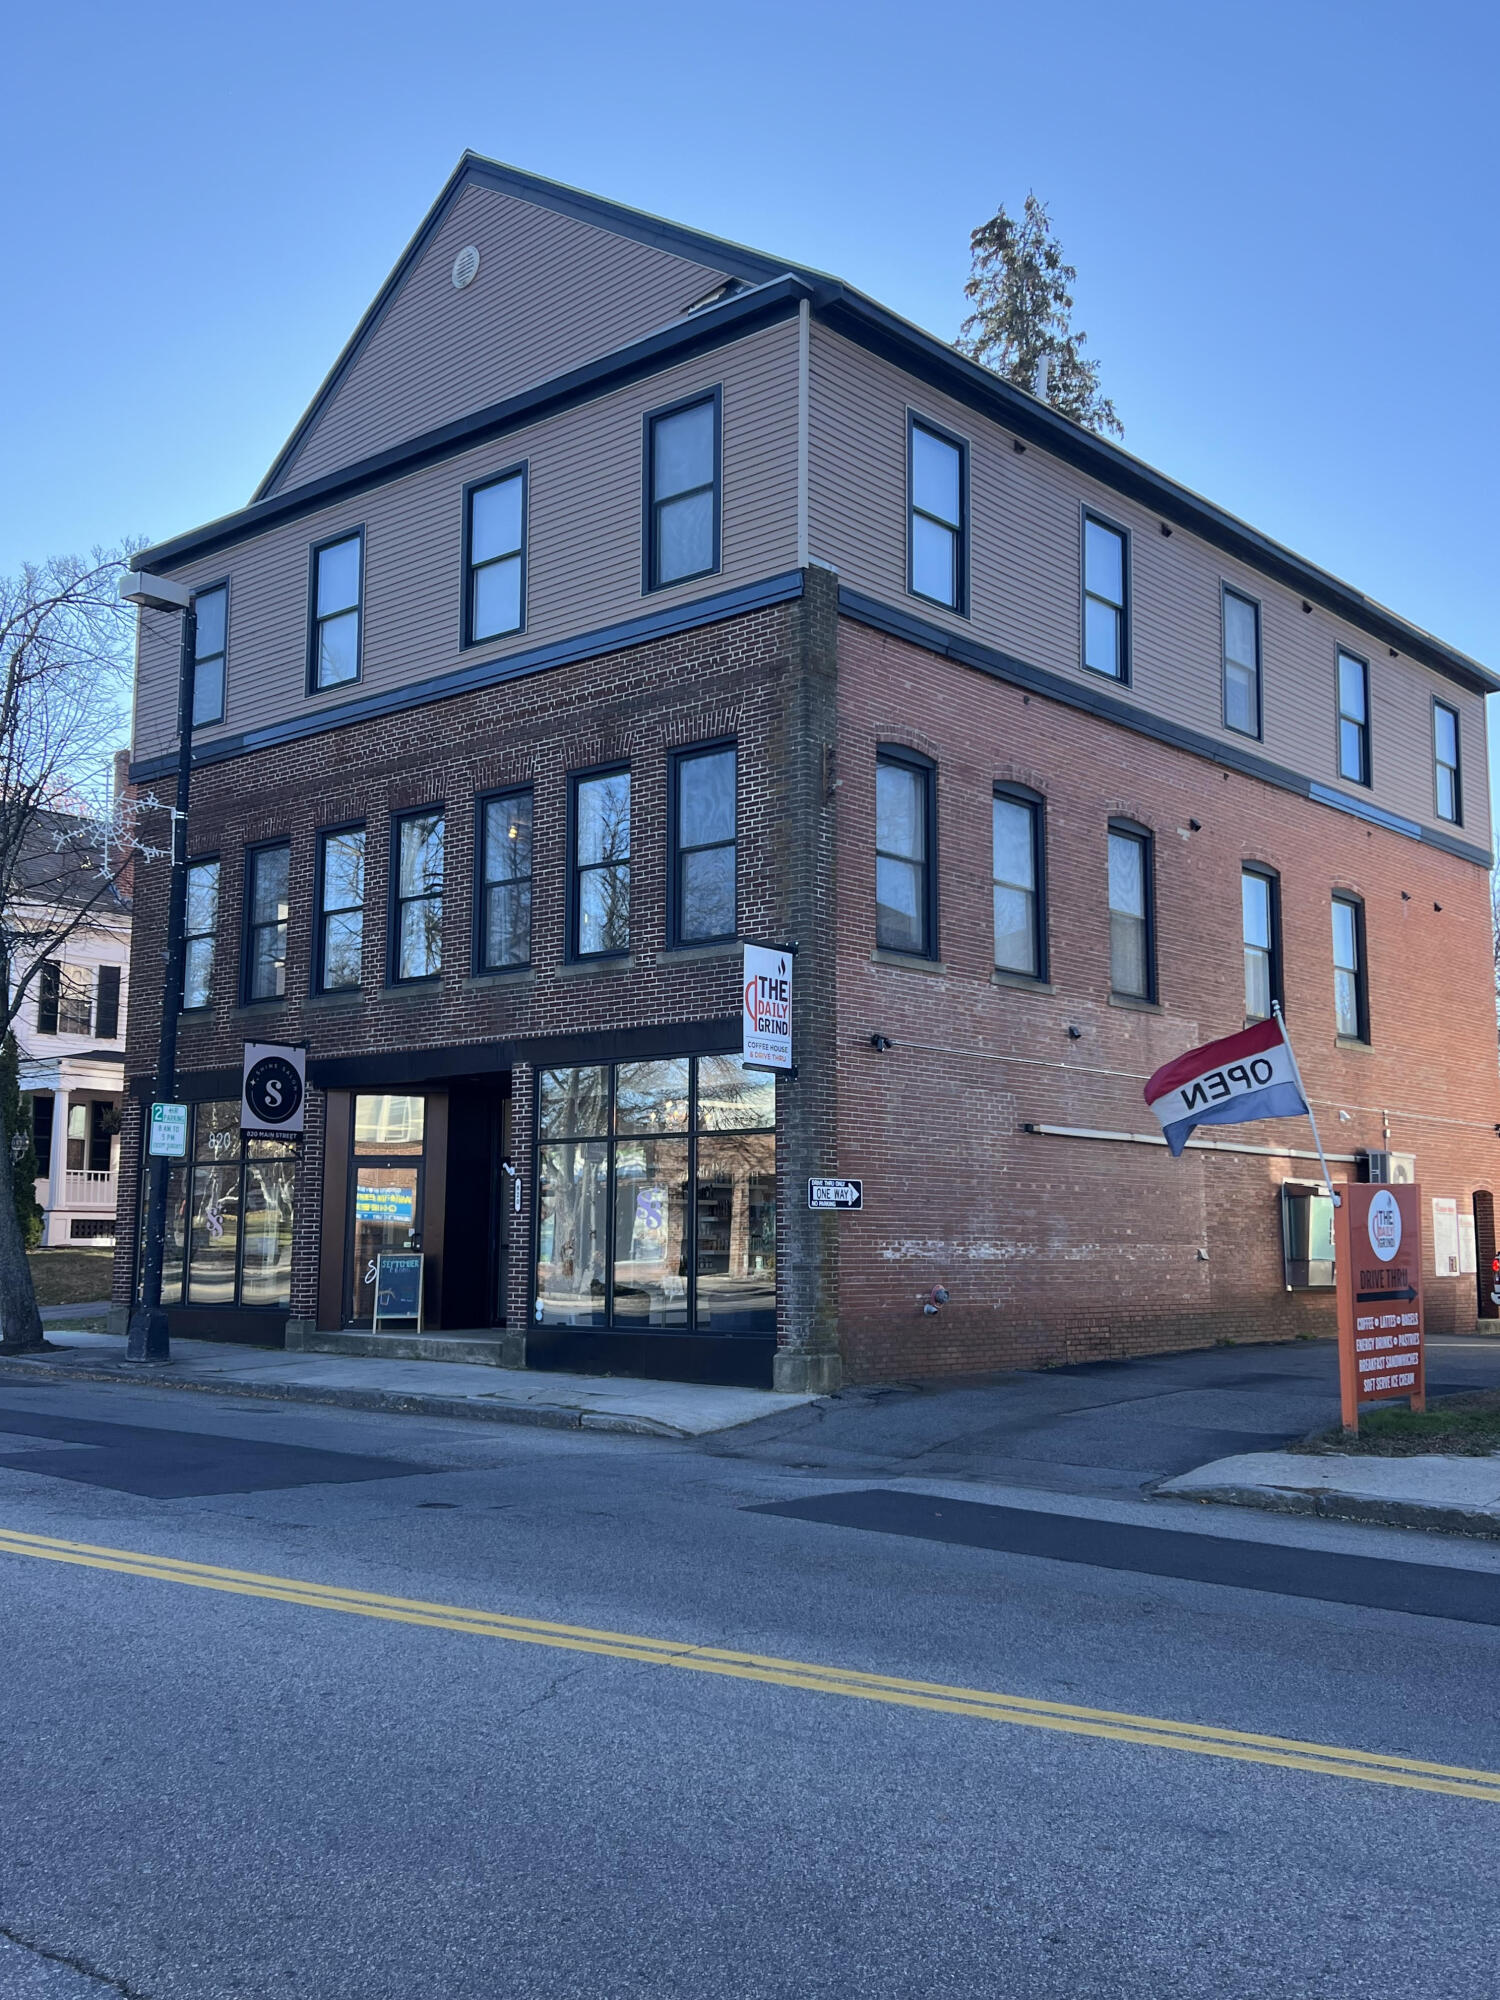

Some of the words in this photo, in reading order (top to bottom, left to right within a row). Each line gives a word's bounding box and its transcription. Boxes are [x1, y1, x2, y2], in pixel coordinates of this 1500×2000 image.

[758, 976, 788, 1002] THE
[758, 1000, 788, 1019] DAILY
[758, 1018, 788, 1035] GRIND
[747, 1041, 769, 1051] COFFEE
[770, 1044, 788, 1053] HOUSE
[749, 1050, 754, 1058] &
[754, 1052, 771, 1060] DRIVE
[772, 1054, 787, 1062] THRU
[264, 1080, 282, 1107] S
[154, 1106, 163, 1121] 2
[208, 1132, 231, 1149] 820
[259, 1131, 275, 1139] MAIN
[275, 1132, 298, 1140] STREET
[816, 1187, 831, 1200] ONE
[834, 1188, 849, 1200] WAY
[1378, 1210, 1394, 1226] THE
[1360, 1269, 1384, 1289] DRIVE
[1386, 1269, 1408, 1288] THRU
[1357, 1317, 1375, 1331] COFFEE
[1380, 1314, 1397, 1329] LATTES
[1356, 1338, 1375, 1352] ENERGY
[1376, 1336, 1393, 1350] DRINKS
[1399, 1333, 1420, 1347] PASTRIES
[1359, 1356, 1385, 1372] BREAKFAST
[1386, 1352, 1418, 1368] SANDWICHES
[1364, 1378, 1375, 1392] SOFT
[1376, 1376, 1390, 1390] SERVE
[1399, 1373, 1415, 1386] CREAM
